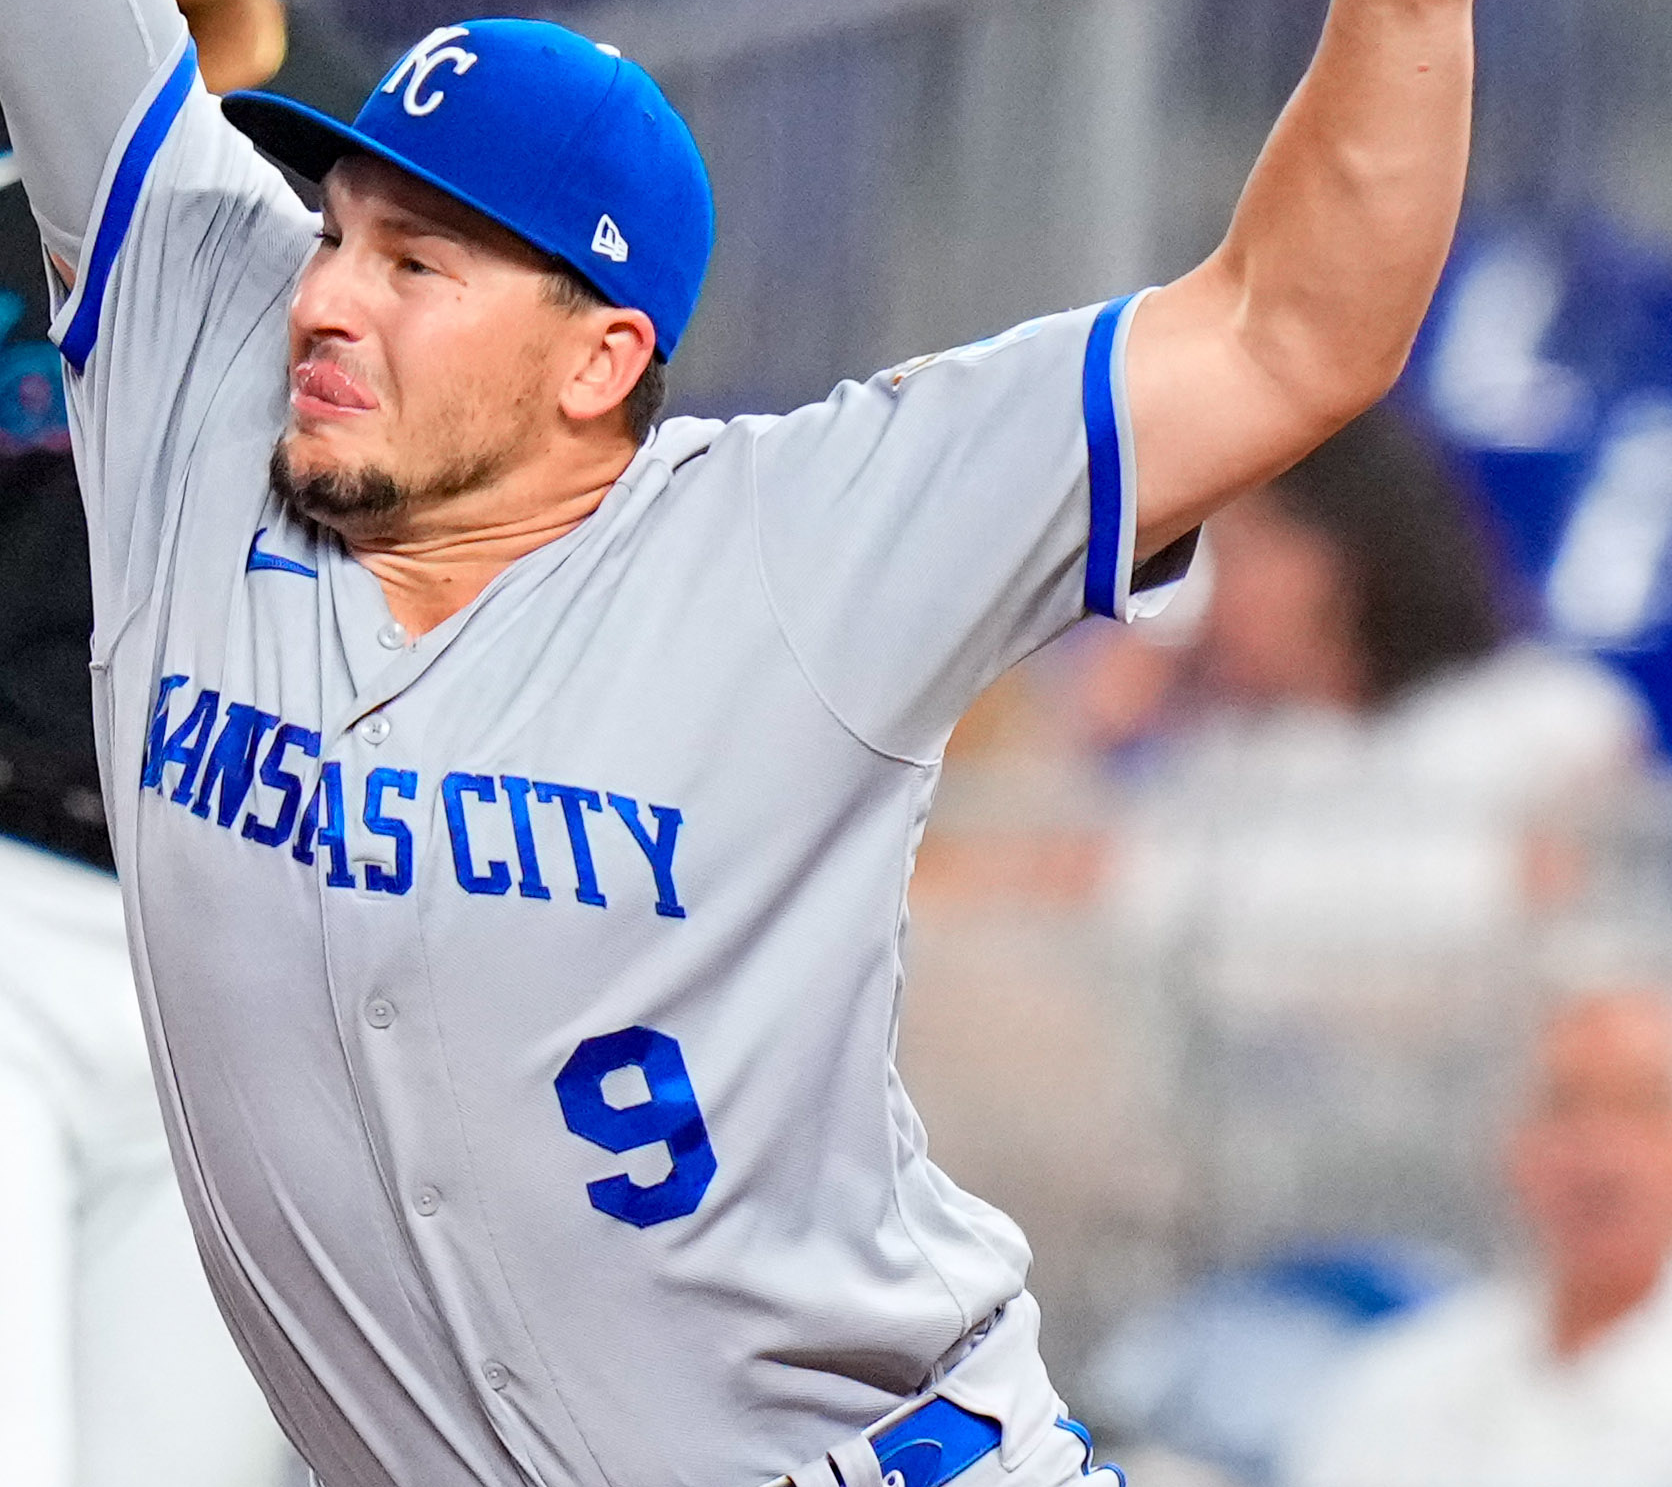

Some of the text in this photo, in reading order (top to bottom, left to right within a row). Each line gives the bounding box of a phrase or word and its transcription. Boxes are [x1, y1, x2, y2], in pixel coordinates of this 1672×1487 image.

[381, 26, 478, 116] KC
[440, 770, 687, 919] CITY
[554, 1025, 719, 1229] 9
